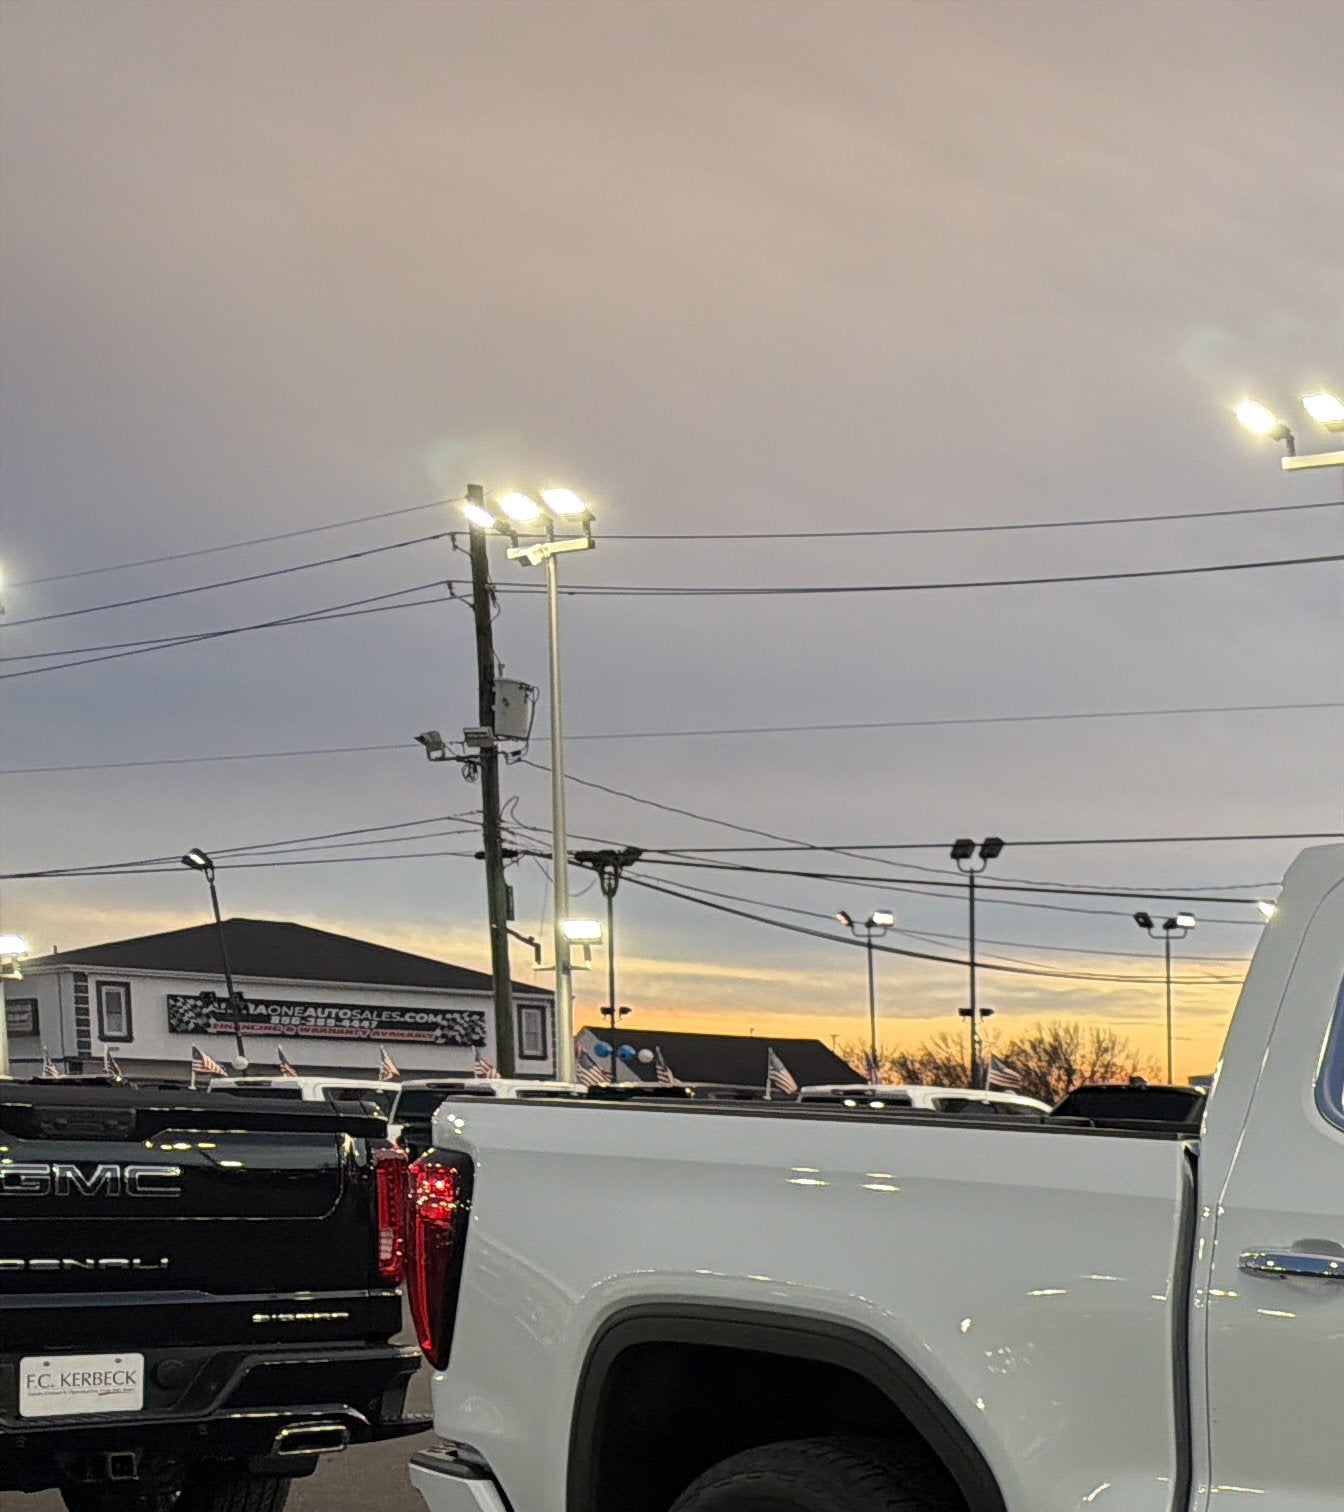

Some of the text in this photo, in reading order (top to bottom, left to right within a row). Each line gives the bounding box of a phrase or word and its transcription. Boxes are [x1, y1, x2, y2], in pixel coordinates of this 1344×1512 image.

[213, 1022, 282, 1033] FINNCING
[0, 1163, 182, 1197] GMC
[26, 1370, 137, 1389] F.C. KERBECK
